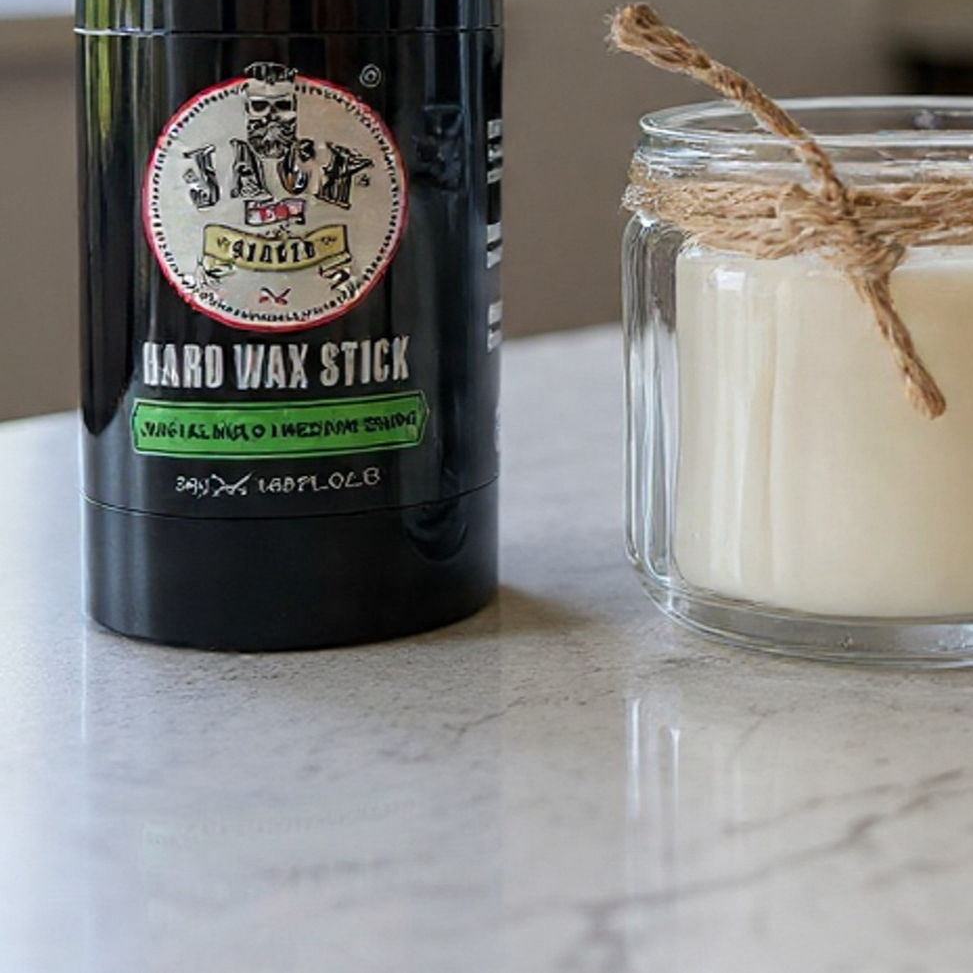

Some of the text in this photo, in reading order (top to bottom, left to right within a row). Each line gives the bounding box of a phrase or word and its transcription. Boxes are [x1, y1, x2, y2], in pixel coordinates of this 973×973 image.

[142, 335, 410, 390] HARD WAX STICK
